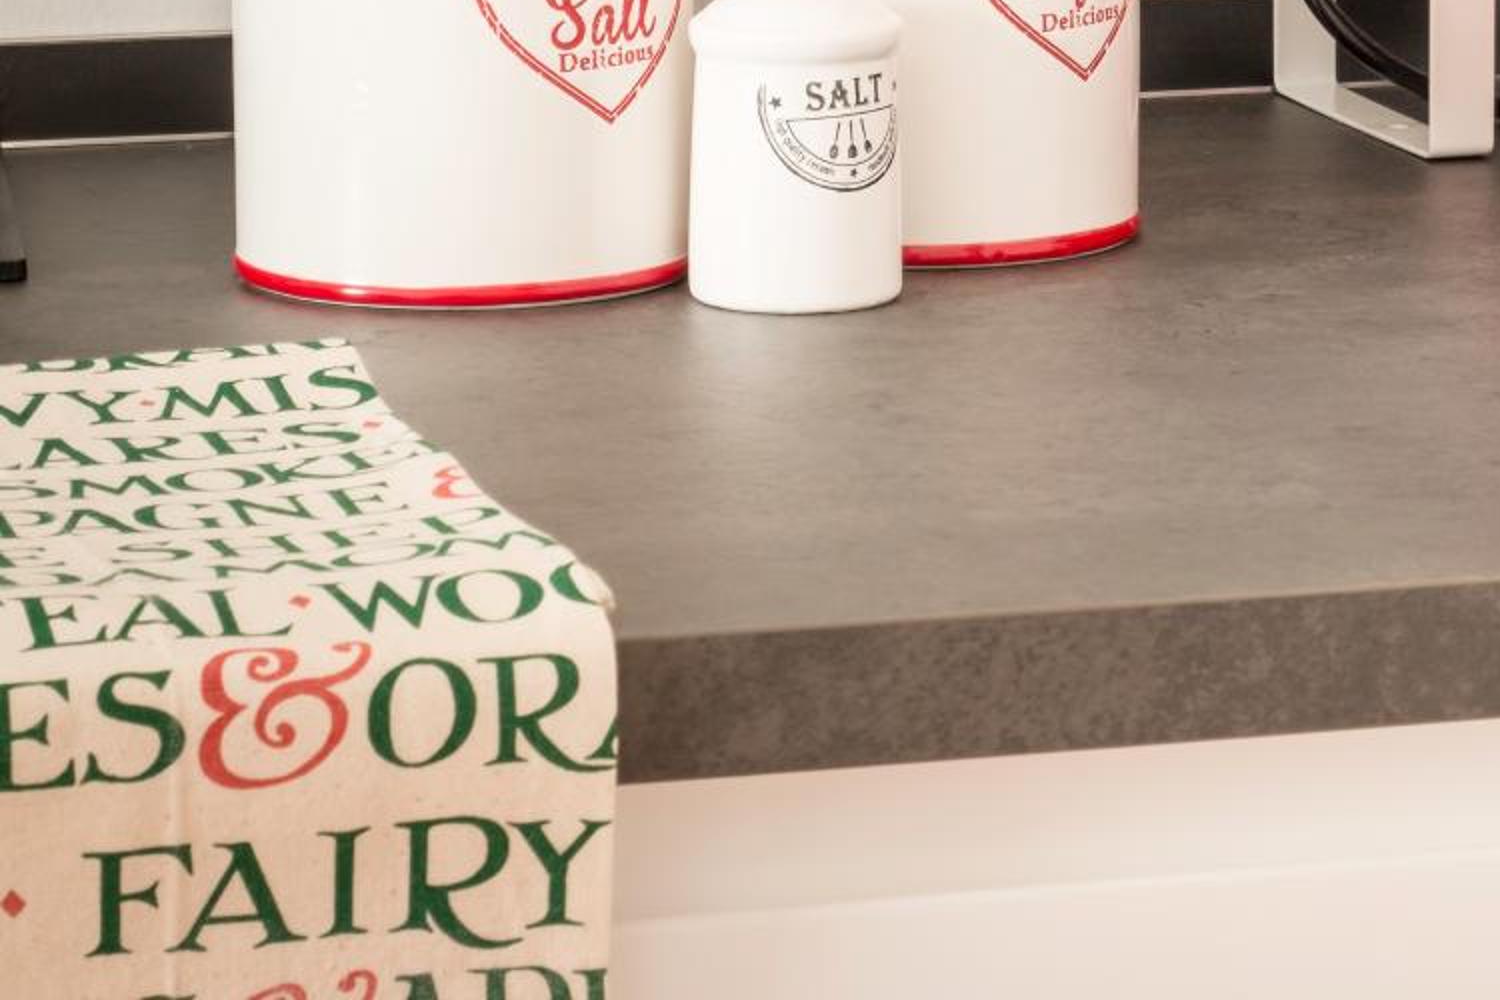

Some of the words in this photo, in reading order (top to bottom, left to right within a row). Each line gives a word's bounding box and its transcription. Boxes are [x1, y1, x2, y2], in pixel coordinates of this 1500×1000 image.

[1041, 3, 1120, 32] Delicious
[559, 45, 654, 72] Delicious
[805, 72, 882, 111] SALT
[153, 365, 378, 420] MIS
[0, 421, 362, 470] ARES
[198, 641, 373, 789] &
[368, 653, 617, 773] OR
[82, 816, 612, 957] FAIRY
